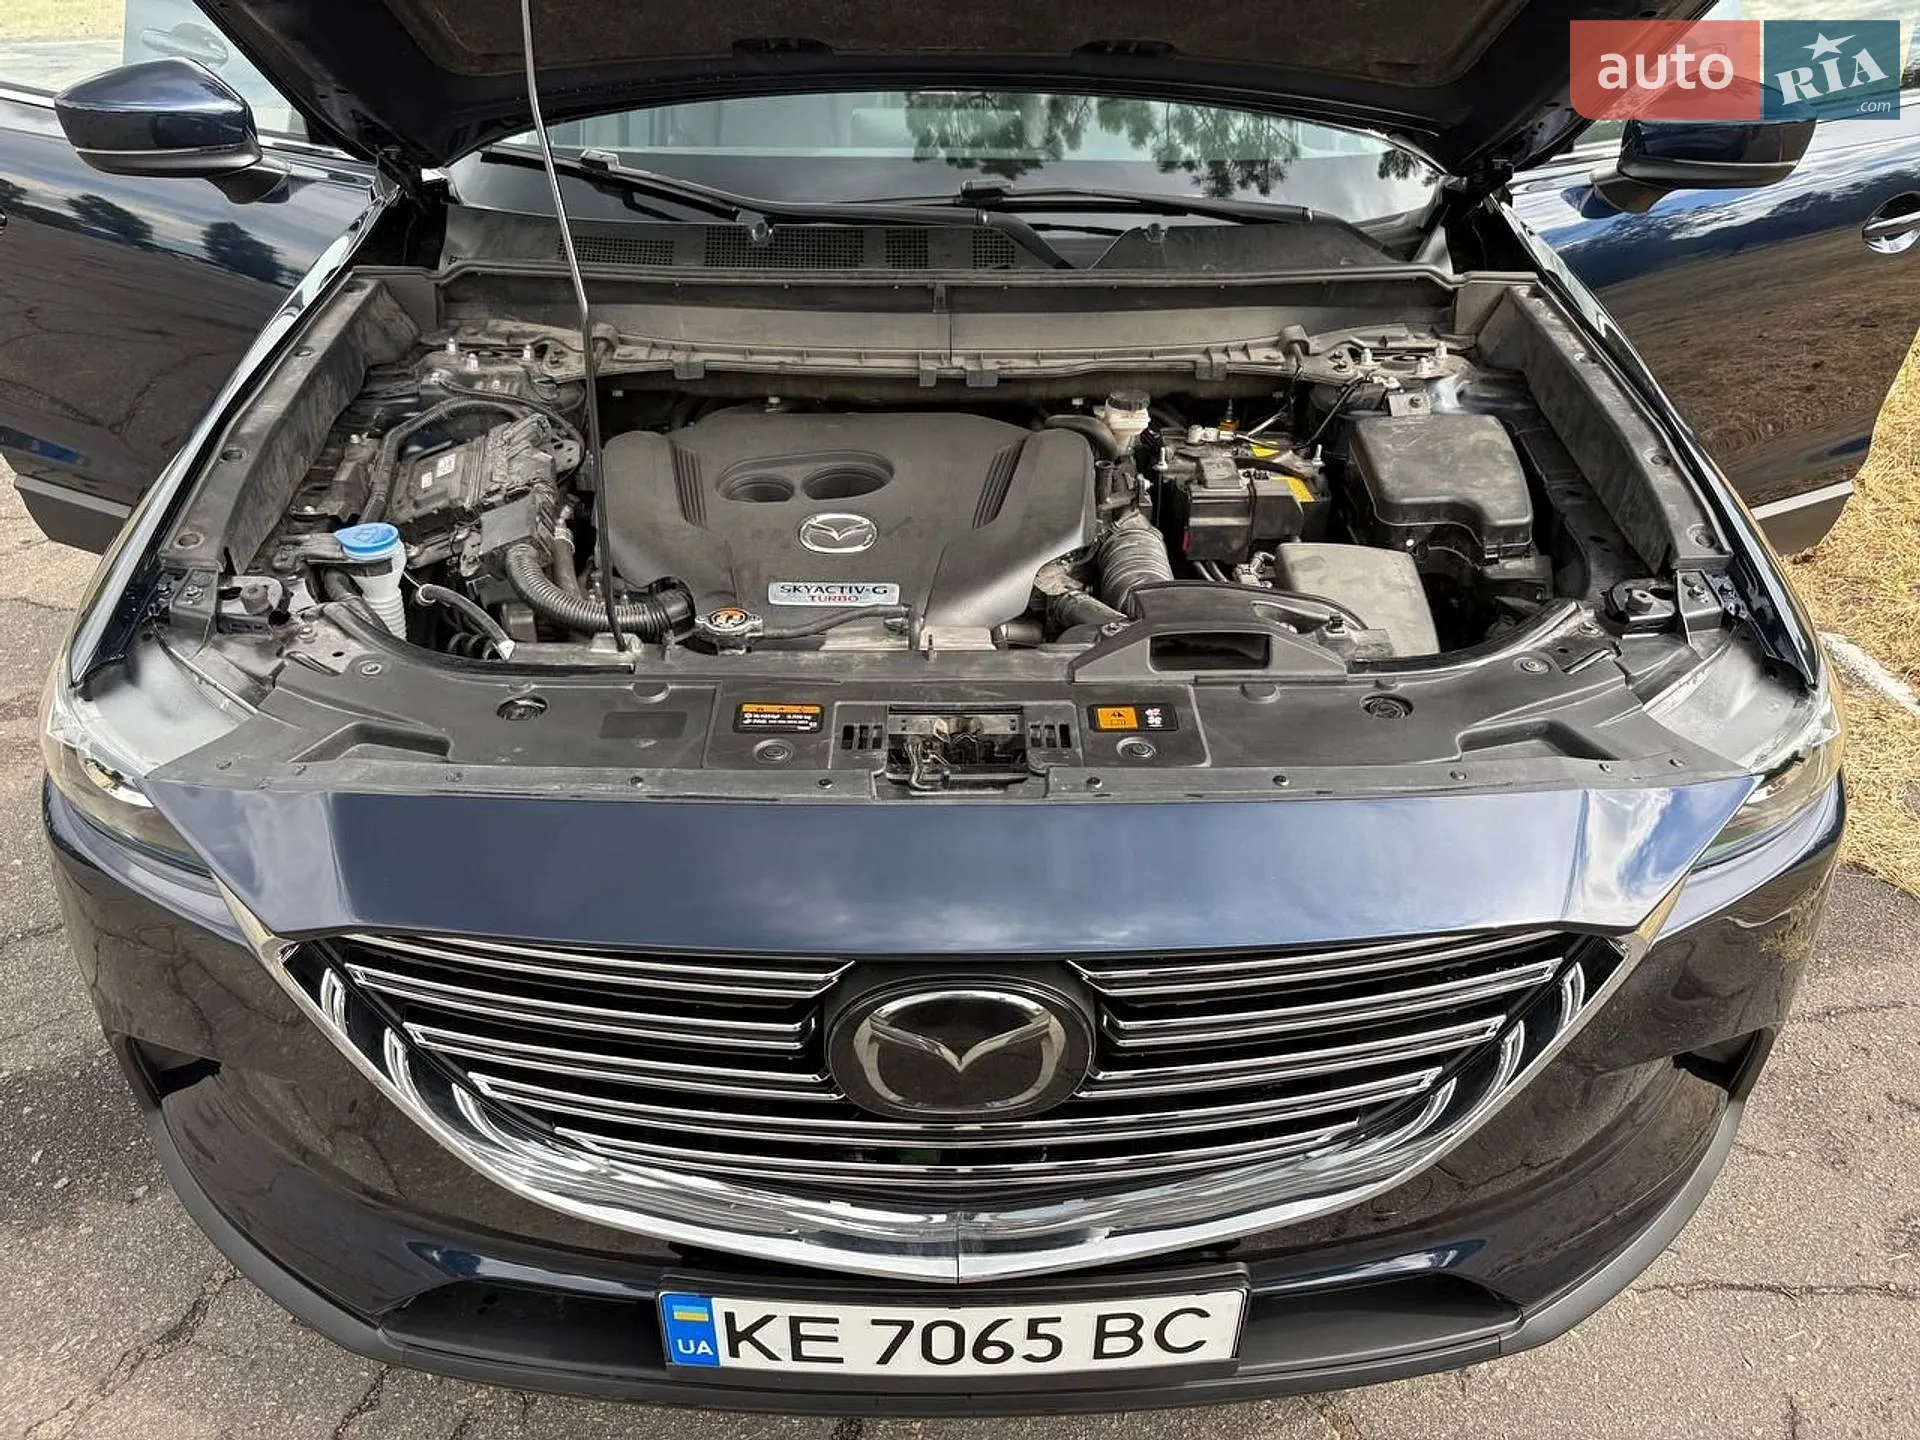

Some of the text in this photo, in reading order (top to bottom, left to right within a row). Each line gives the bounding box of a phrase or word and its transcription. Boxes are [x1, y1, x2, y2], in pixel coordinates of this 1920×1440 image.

[780, 585, 888, 595] SKYACTIV-G
[808, 595, 858, 603] TURBO
[724, 1307, 1212, 1366] KE 7065 BC
[678, 1339, 714, 1356] UA
